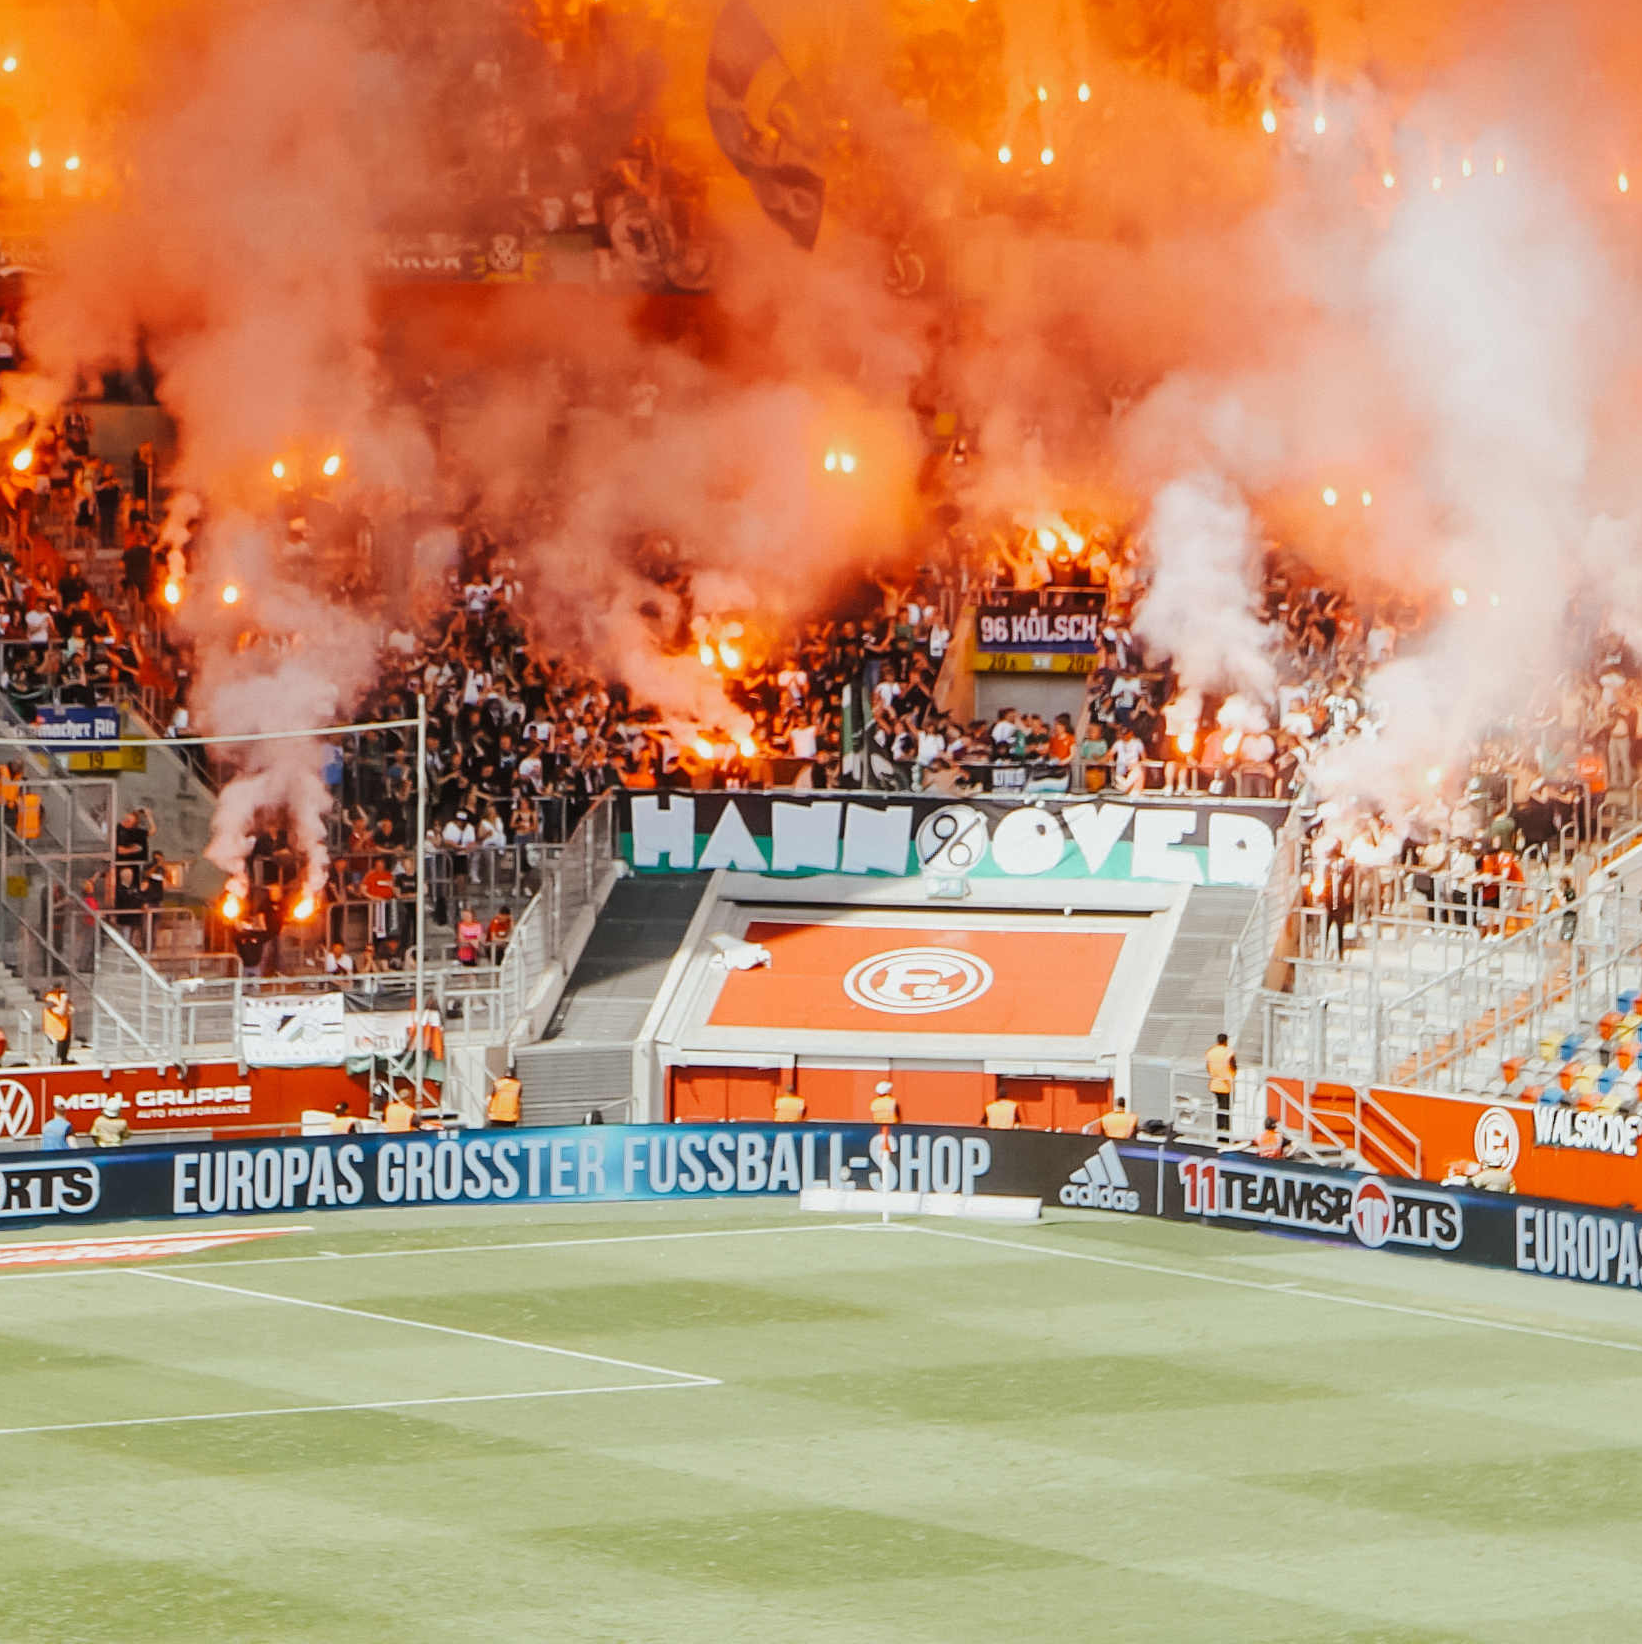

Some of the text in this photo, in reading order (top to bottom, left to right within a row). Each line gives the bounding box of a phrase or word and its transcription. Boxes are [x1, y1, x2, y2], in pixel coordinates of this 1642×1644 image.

[981, 615, 1009, 643] 96
[89, 752, 105, 770] 19
[135, 1085, 252, 1107] GRUPPE
[136, 1105, 251, 1119] AUTO PERFORMANCE
[1532, 1105, 1641, 1157] WALSRODE
[173, 1131, 992, 1215] EUROPAS GRÖSSTER FUSSBALL-SHOP
[1059, 1183, 1140, 1213] adidas
